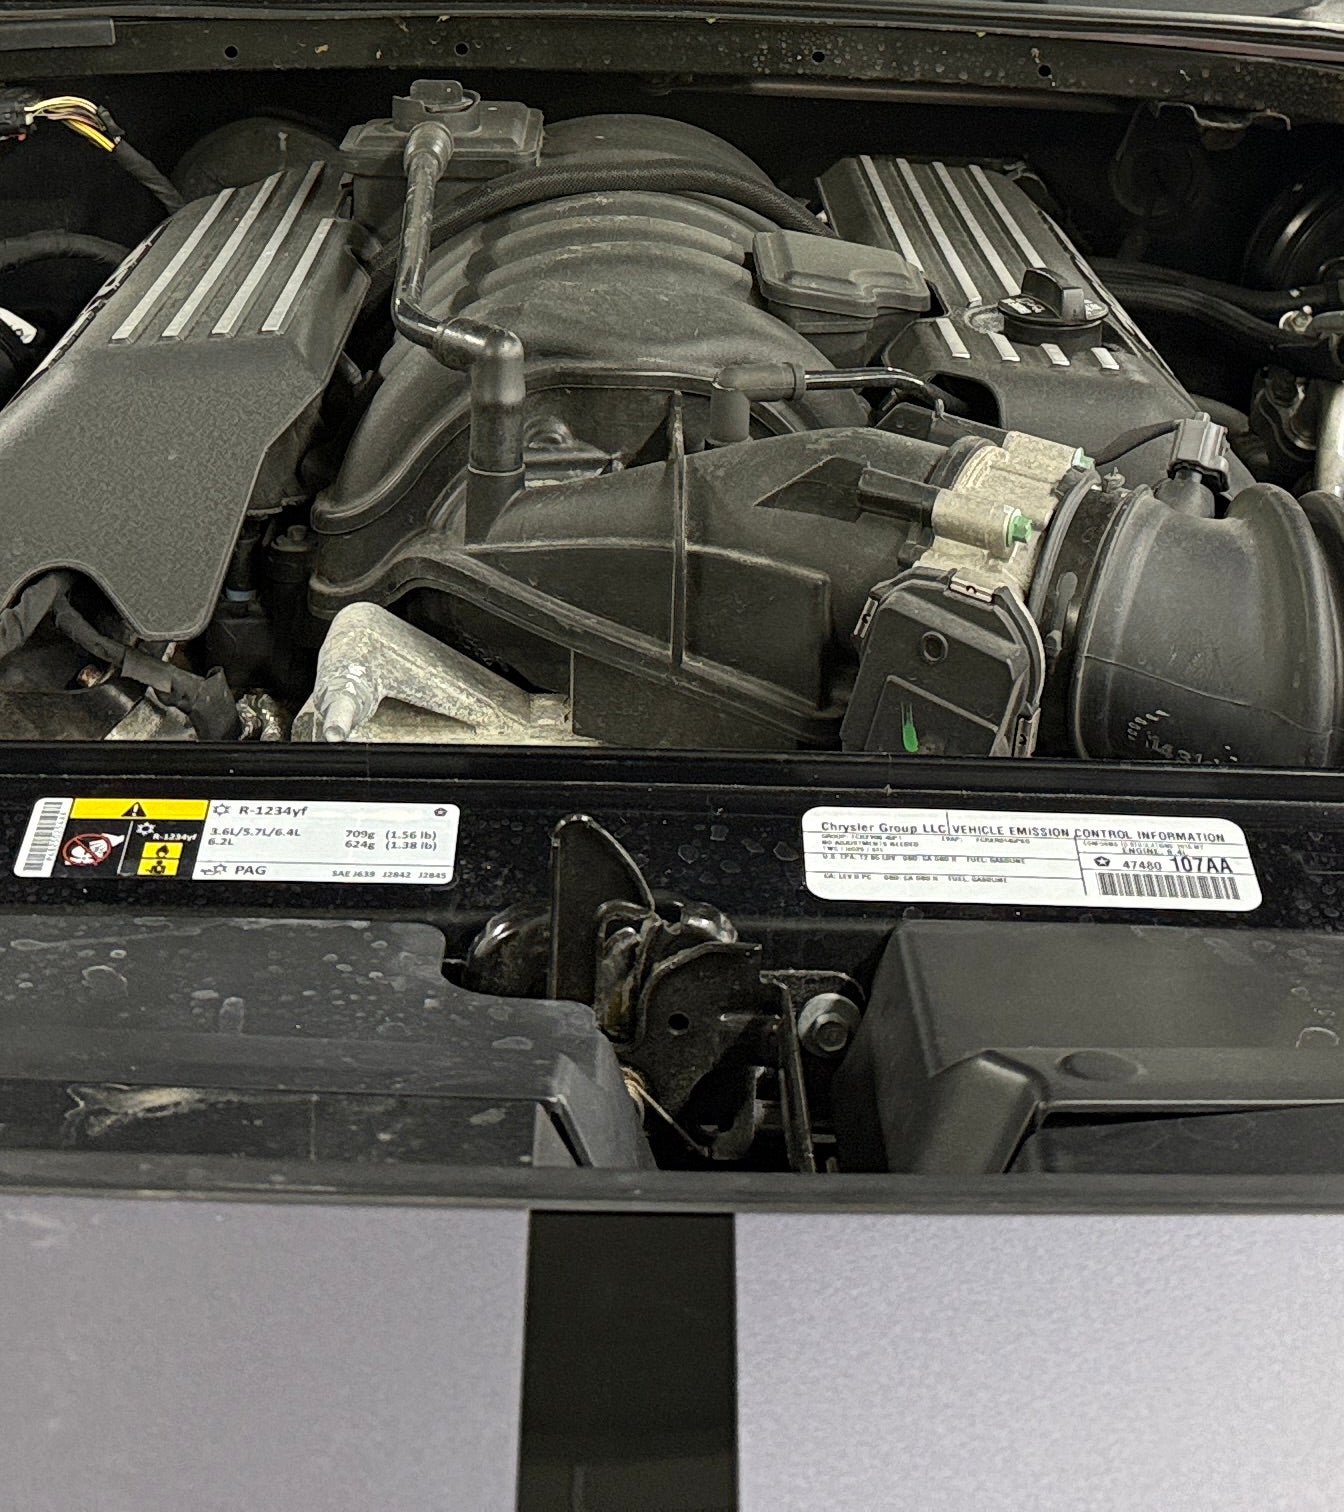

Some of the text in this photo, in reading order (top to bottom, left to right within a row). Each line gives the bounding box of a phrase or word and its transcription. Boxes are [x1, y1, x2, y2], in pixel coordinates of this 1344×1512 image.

[239, 805, 308, 817] R-1234yf
[209, 827, 301, 837] 3.6L/5.7L/6.4L
[821, 821, 947, 835] Chrysler Group LLC
[951, 824, 1226, 843] VEHICLE EMISSION CONTROL INFORMATION
[345, 829, 437, 841] 709g (1.56 lb)
[207, 837, 234, 846] 6.2L
[344, 840, 438, 852] 624g (1.38 lb)
[234, 865, 268, 876] PAG
[1170, 856, 1234, 874] 107AA
[332, 870, 351, 878] SAE
